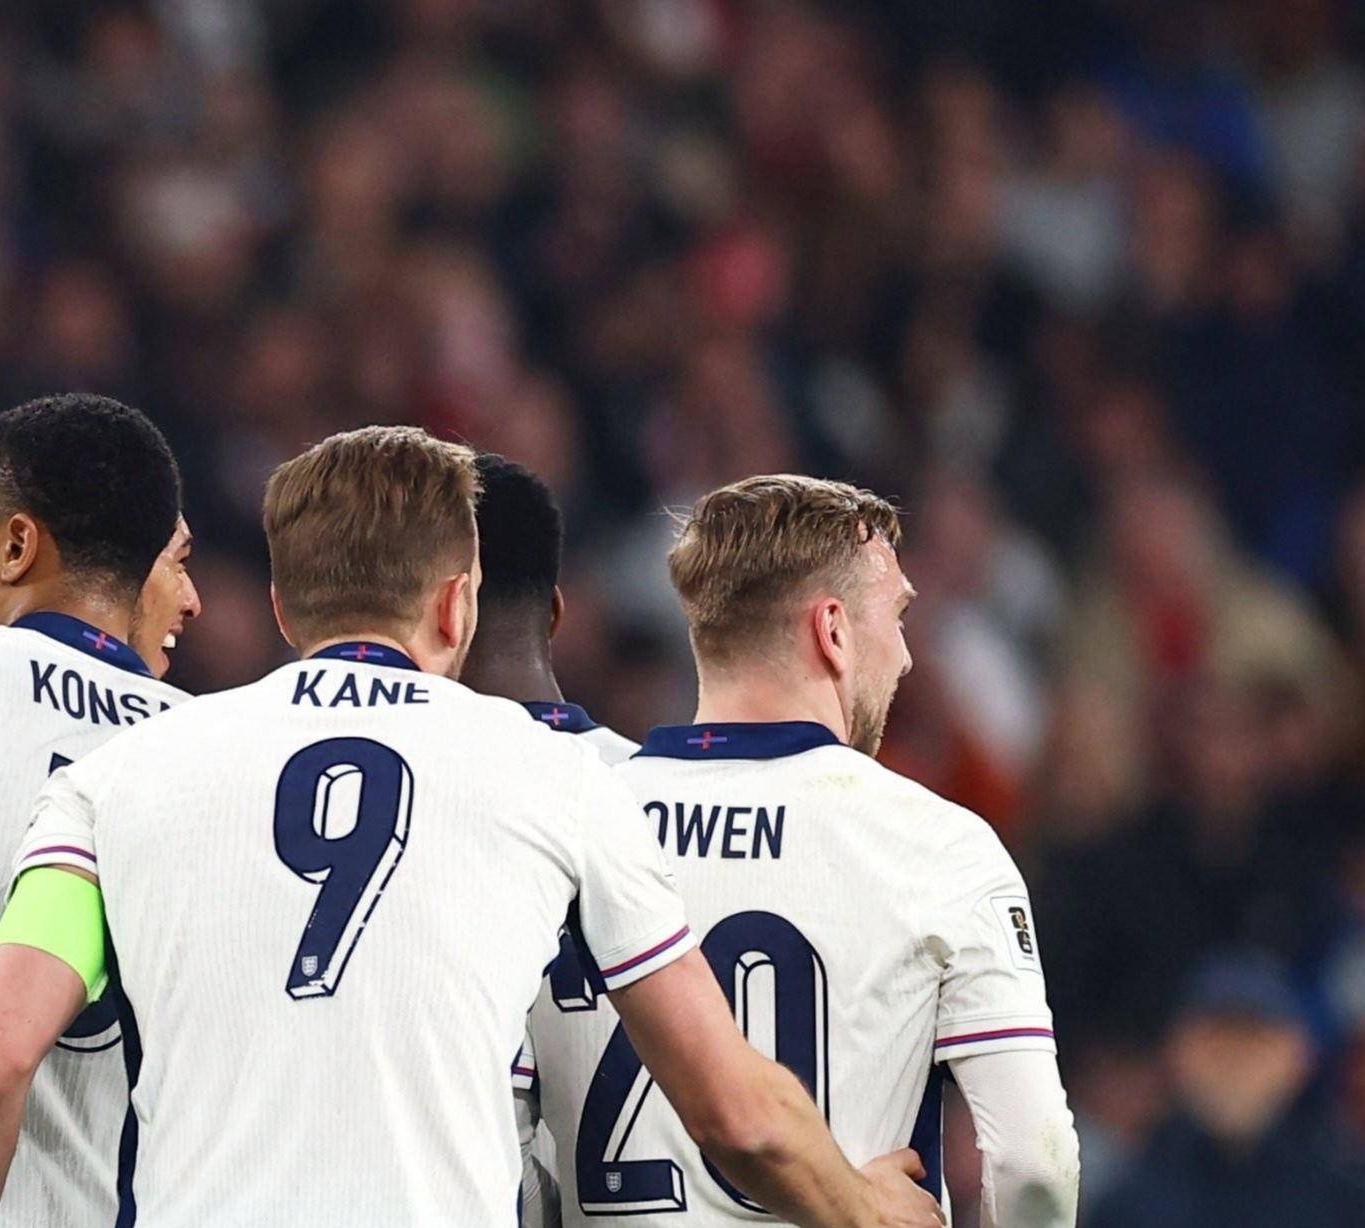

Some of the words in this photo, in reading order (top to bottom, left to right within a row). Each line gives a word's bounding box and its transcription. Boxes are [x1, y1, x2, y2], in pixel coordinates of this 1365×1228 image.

[29, 659, 171, 727] KONS
[291, 669, 430, 708] KANE
[273, 736, 415, 1002] 9
